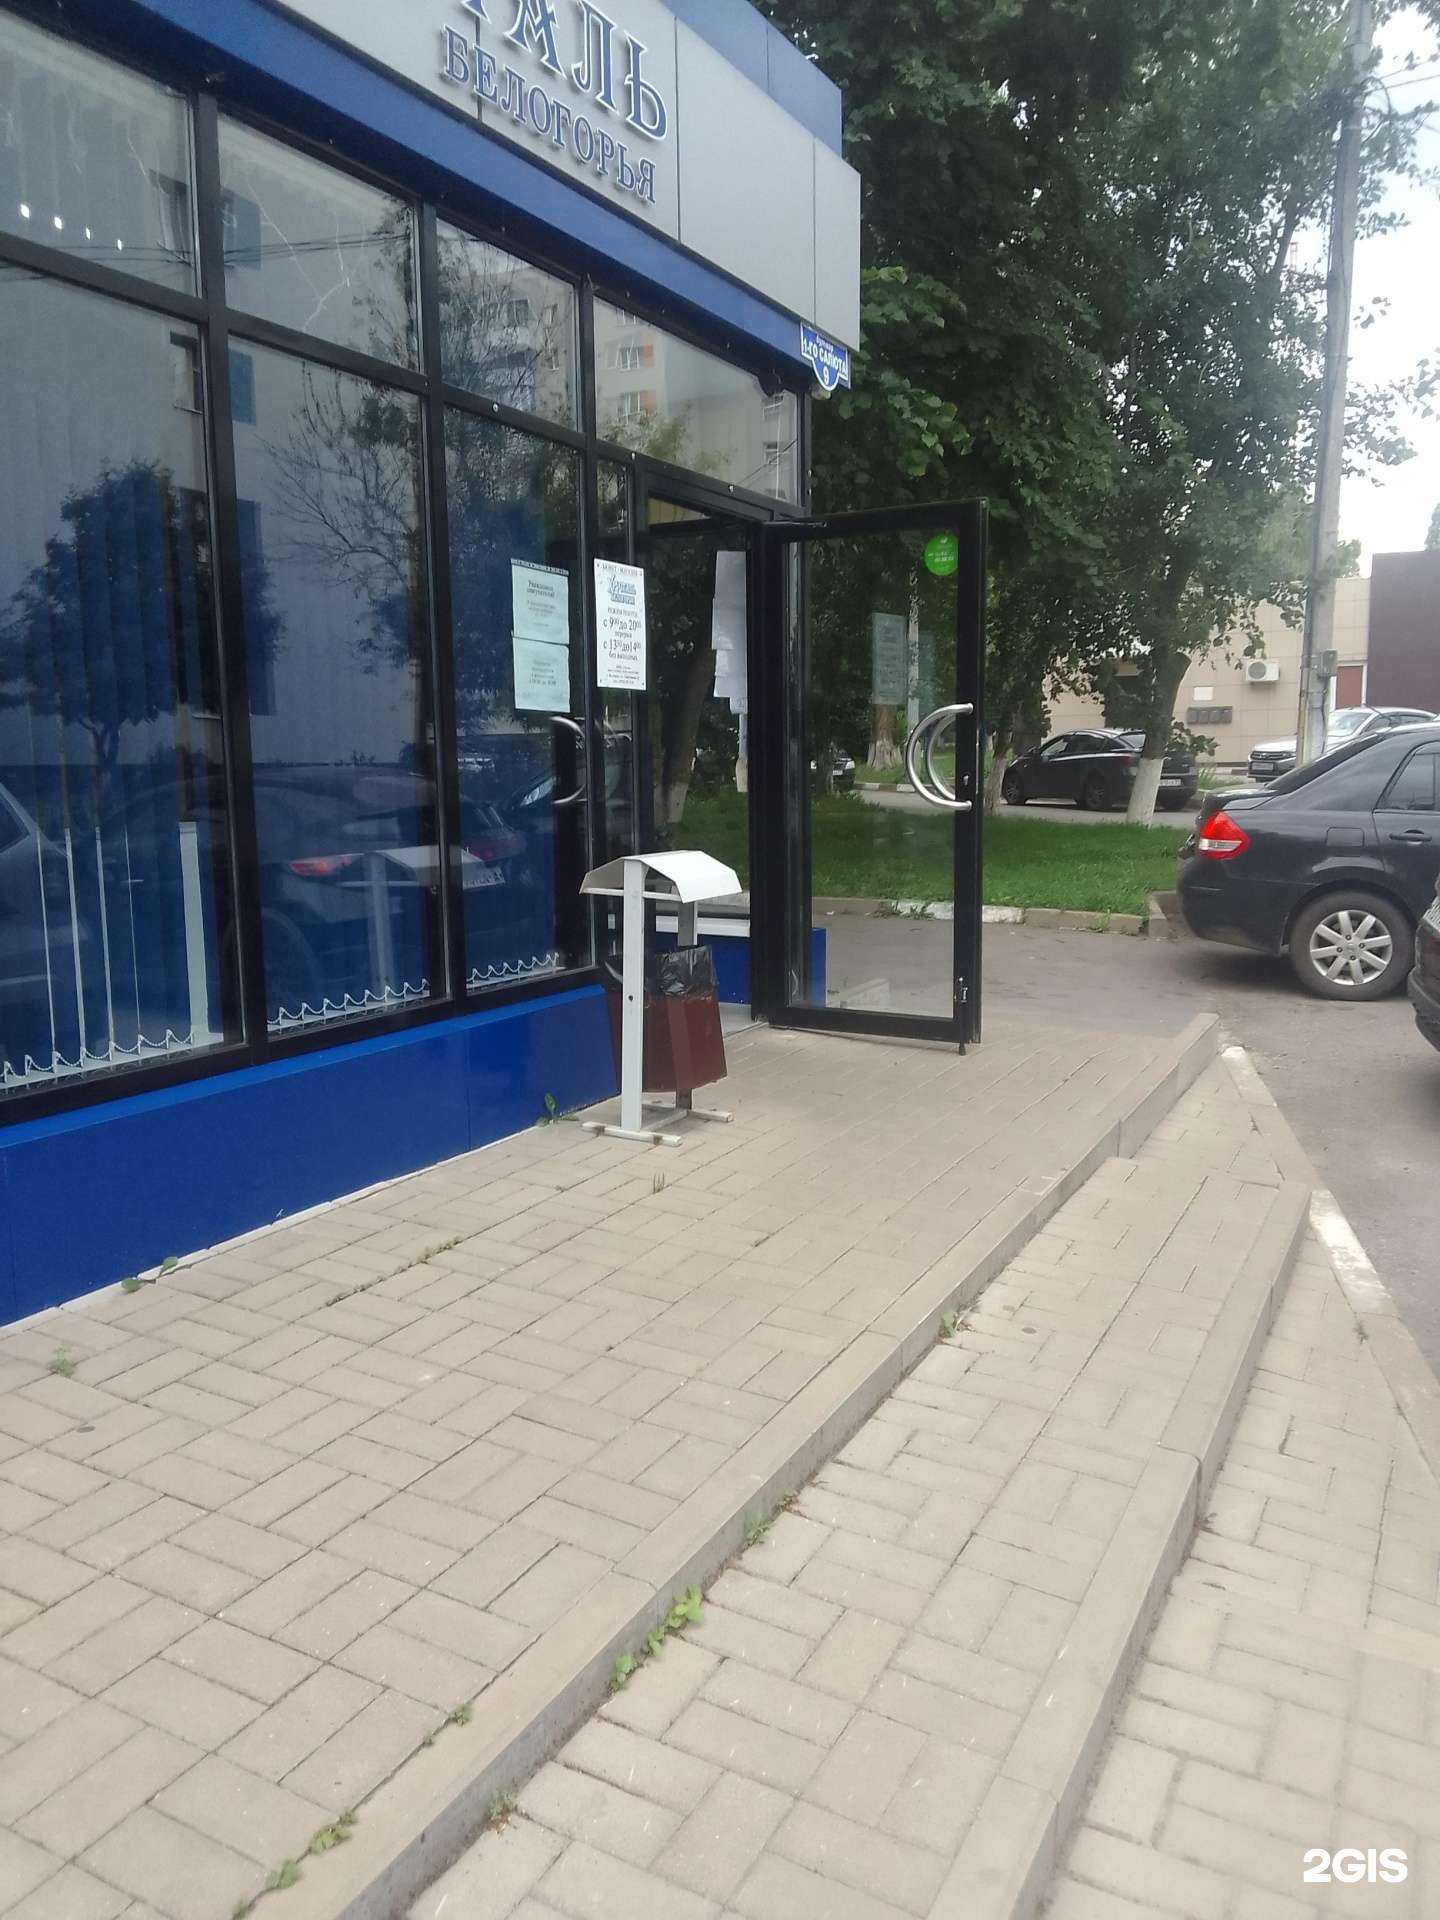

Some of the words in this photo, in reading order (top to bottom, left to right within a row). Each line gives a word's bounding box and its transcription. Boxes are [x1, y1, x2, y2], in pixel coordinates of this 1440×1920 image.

[461, 0, 668, 140] АЛЬ
[442, 24, 656, 204] БЕЛОГОРЬЯ
[819, 347, 847, 377] САЛЮТА
[823, 365, 829, 385] 9
